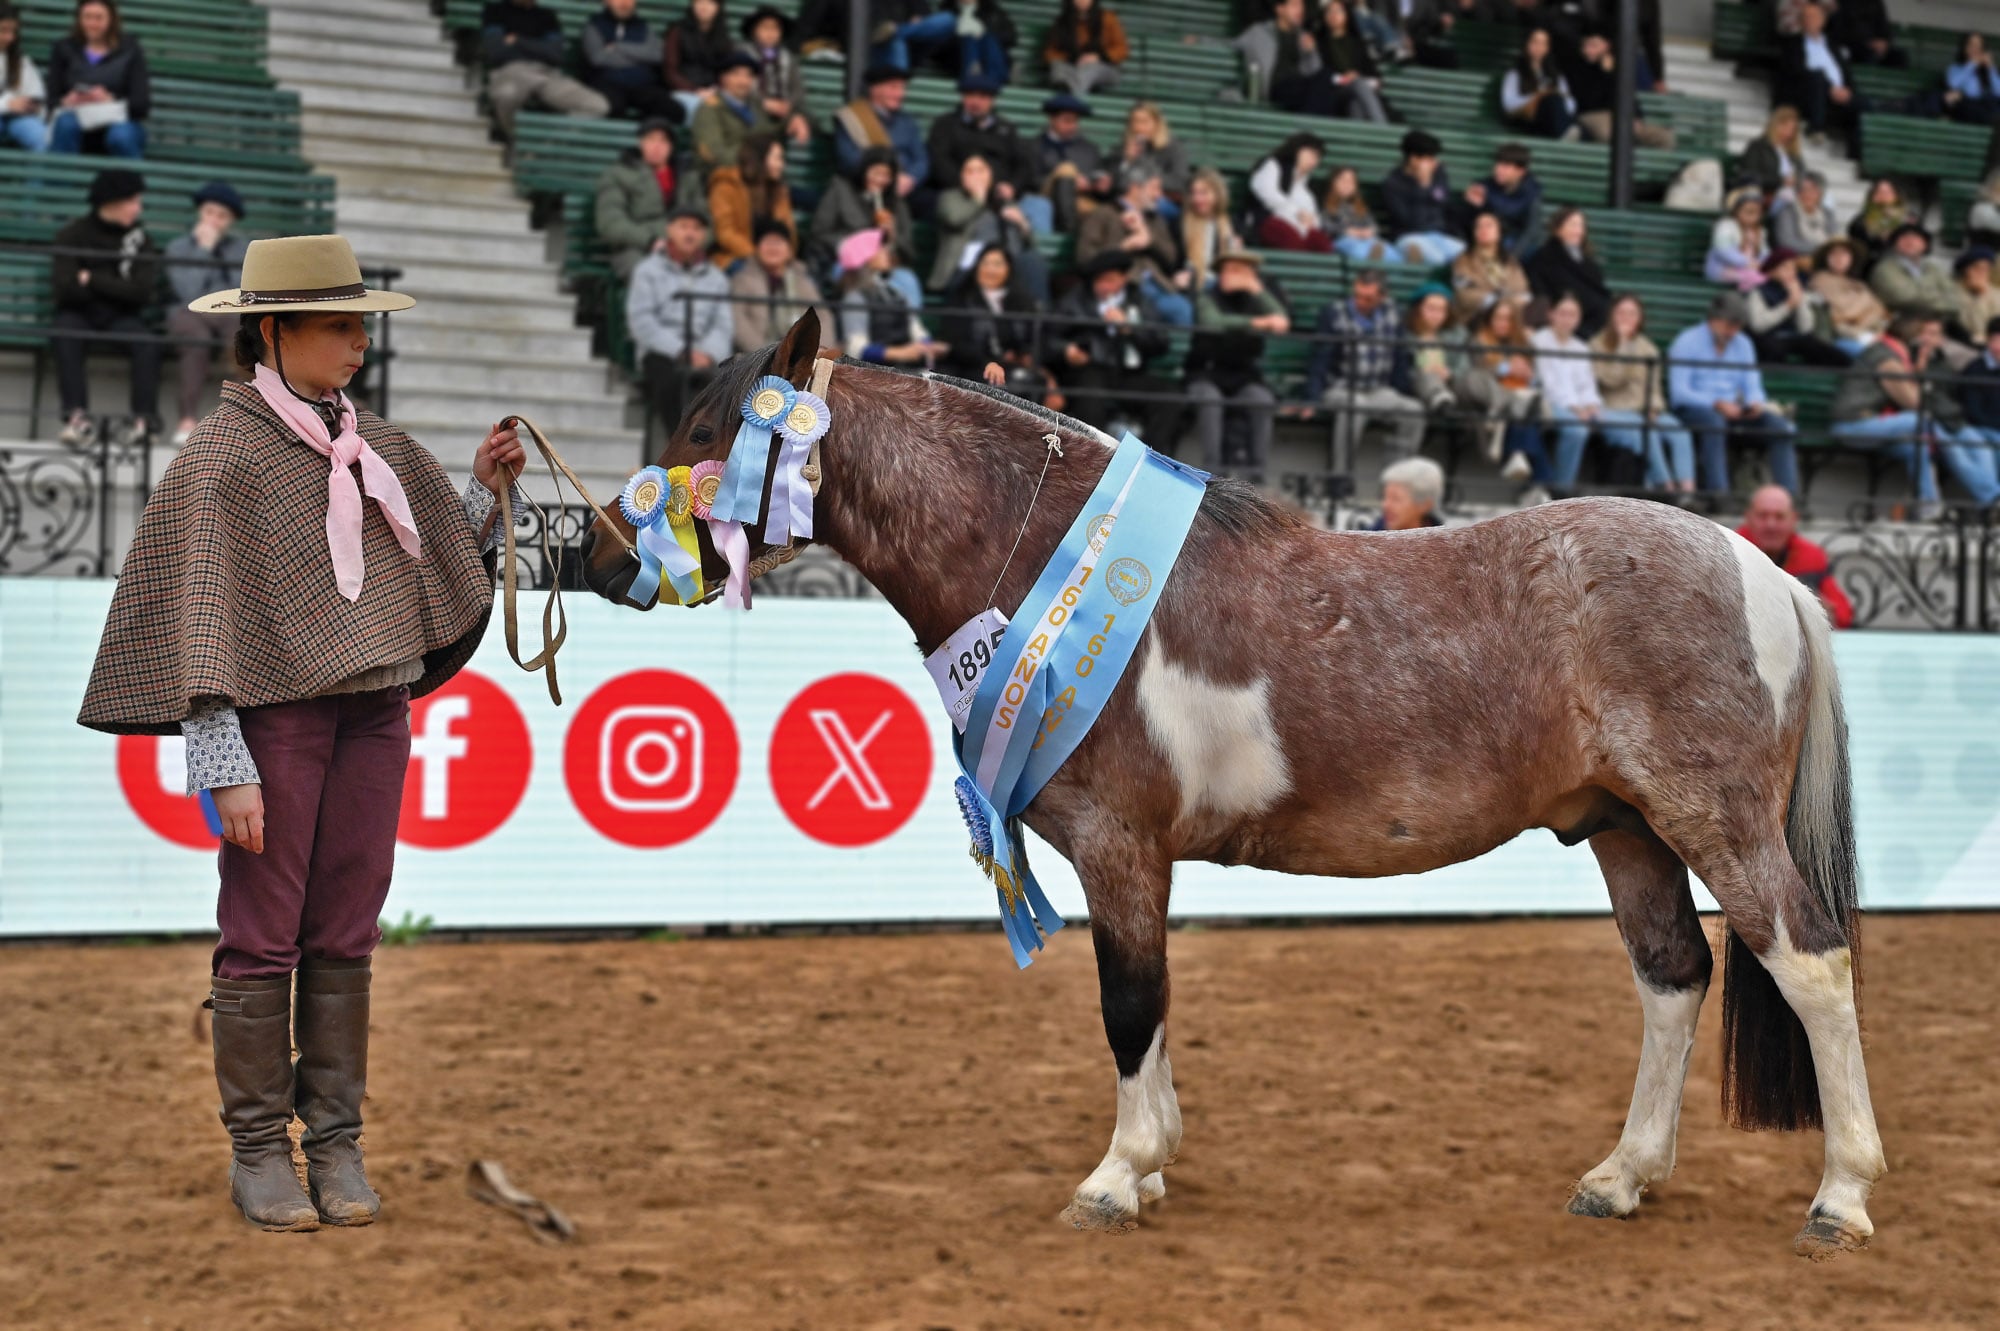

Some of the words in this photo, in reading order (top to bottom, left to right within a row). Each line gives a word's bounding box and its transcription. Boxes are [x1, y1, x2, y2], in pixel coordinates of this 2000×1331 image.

[1048, 566, 1094, 626] 160
[1075, 614, 1116, 678] 160
[995, 633, 1049, 729] AÑOS
